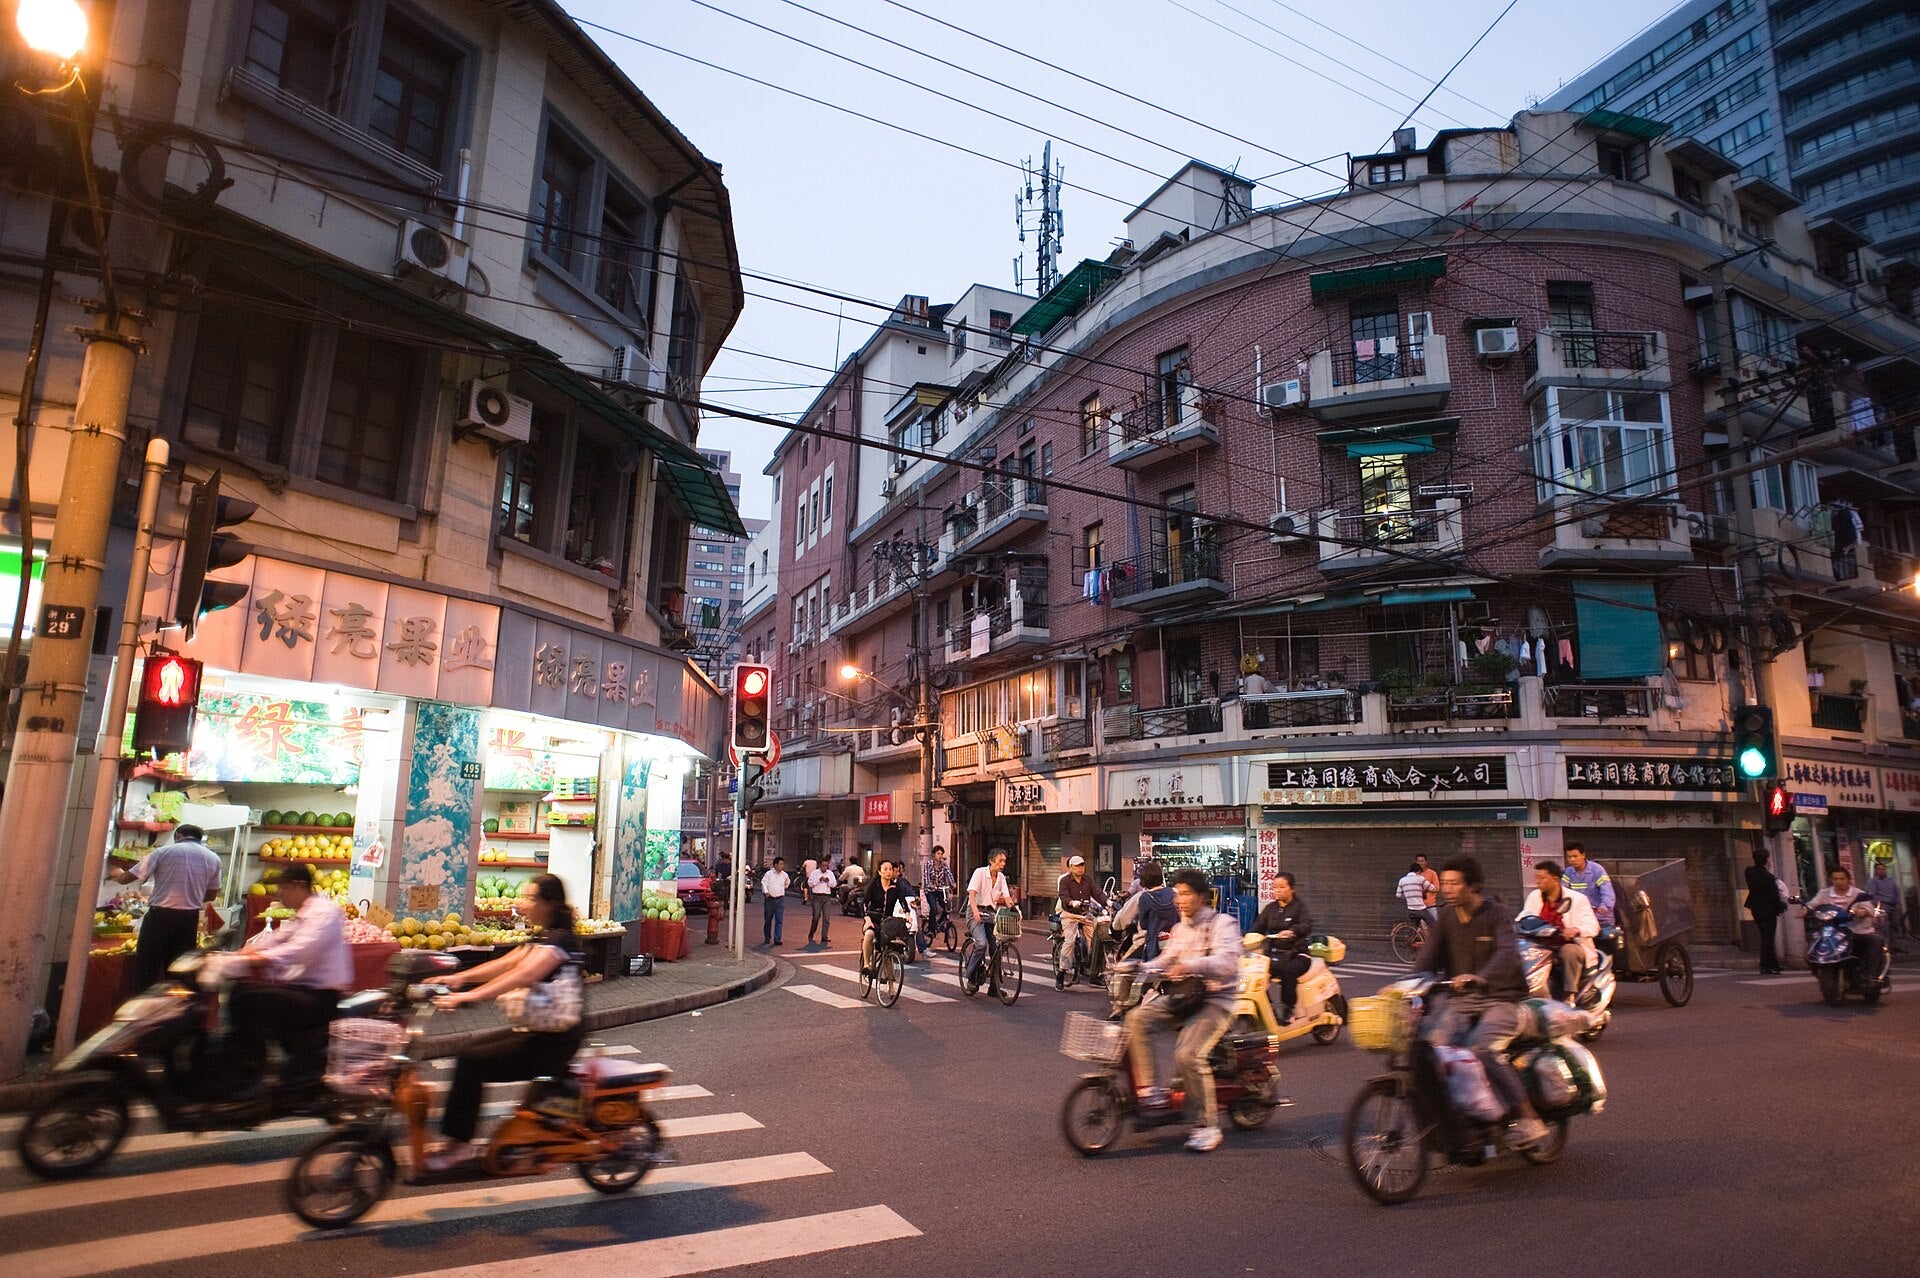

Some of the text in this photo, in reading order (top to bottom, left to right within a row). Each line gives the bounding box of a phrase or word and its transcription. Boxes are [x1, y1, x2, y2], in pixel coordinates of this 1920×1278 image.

[48, 621, 69, 634] 29
[255, 589, 493, 673] 绿亮果业
[536, 642, 655, 708] 绿亮果业
[464, 763, 480, 774] 495
[1259, 830, 1277, 880] 橡胶批发
